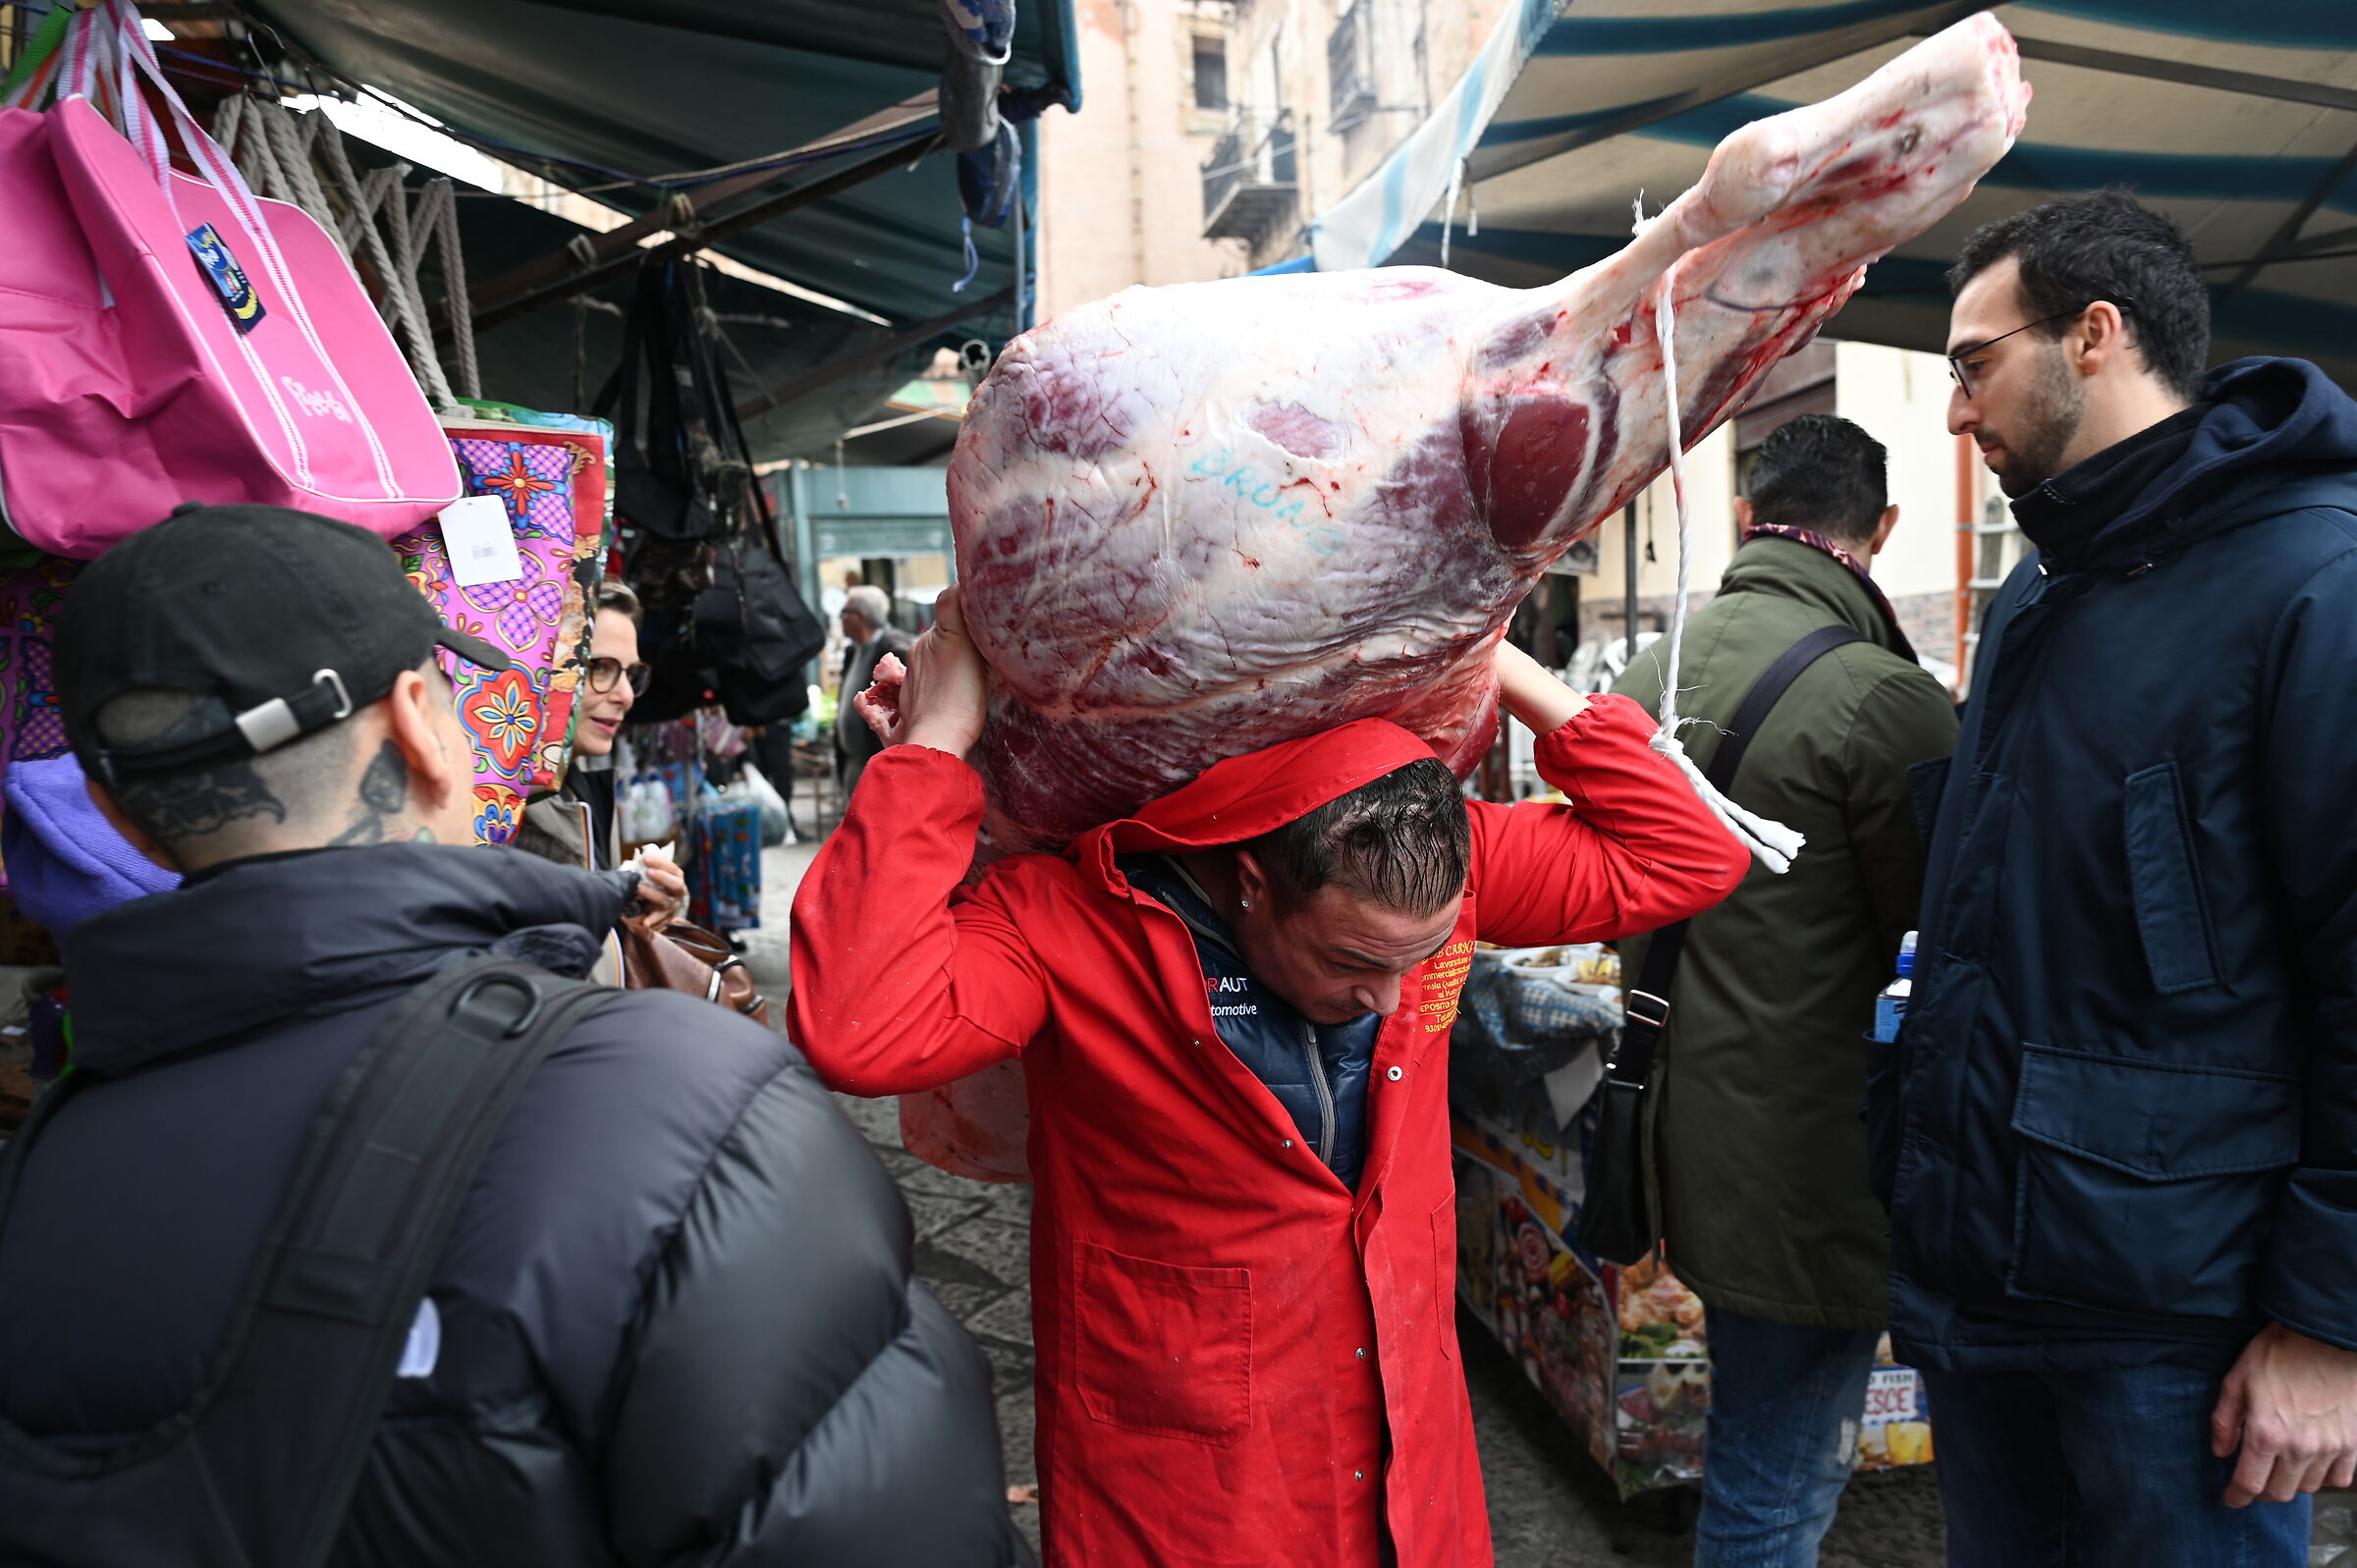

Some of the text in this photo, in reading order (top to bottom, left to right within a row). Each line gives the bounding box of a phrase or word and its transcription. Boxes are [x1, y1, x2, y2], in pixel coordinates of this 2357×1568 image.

[1207, 976, 1248, 993] RAUT
[1210, 1002, 1258, 1016] tomotive
[1865, 1386, 1910, 1415] ESCE
